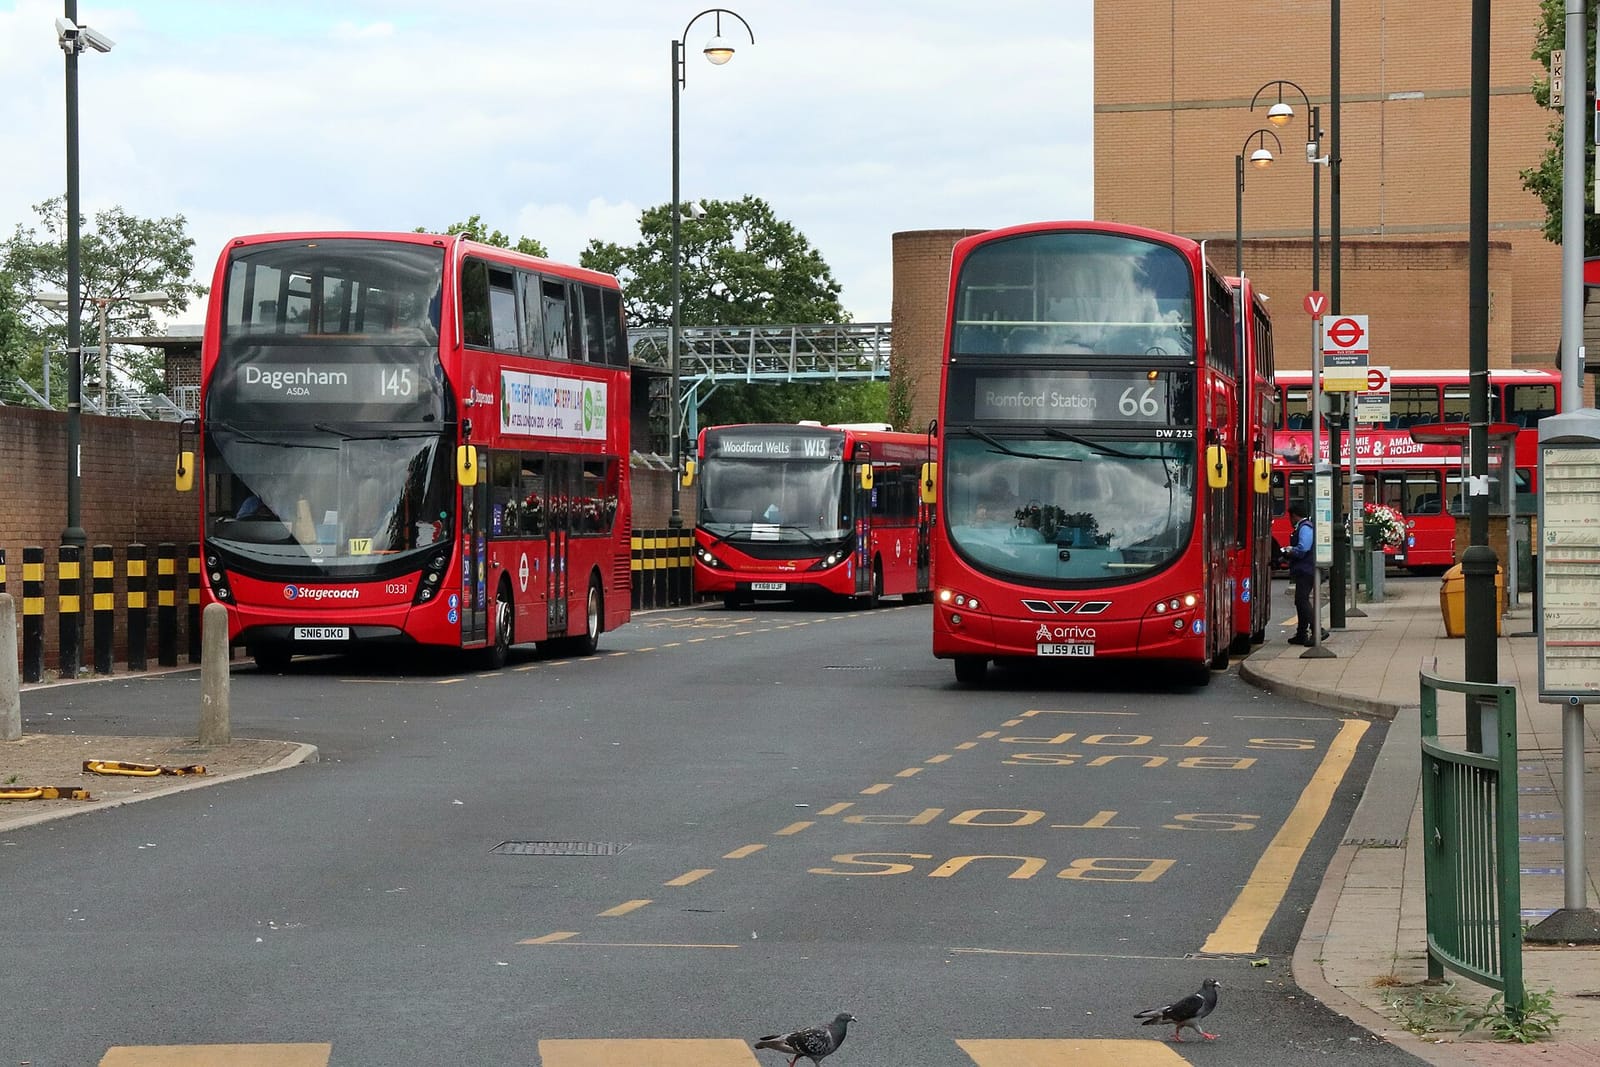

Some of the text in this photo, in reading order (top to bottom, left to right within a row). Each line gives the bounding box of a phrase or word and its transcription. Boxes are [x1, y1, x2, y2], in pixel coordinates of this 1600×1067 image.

[1308, 296, 1324, 313] V
[246, 366, 348, 389] Dagenham
[380, 367, 412, 396] 145
[286, 387, 310, 396] ASDA
[511, 382, 521, 404] THE
[533, 386, 554, 408] HUNGRY
[985, 391, 1097, 409] Romford Station
[1118, 386, 1159, 417] 66
[1155, 430, 1193, 438] DW 225
[1344, 436, 1370, 447] JMIE
[723, 440, 790, 454] Woodford Wells
[803, 439, 826, 457] W13
[1390, 442, 1425, 456] HOLDEN
[353, 539, 369, 552] 117
[298, 587, 360, 601] Stagecoach
[385, 583, 408, 595] 10331
[300, 628, 344, 639] SN16 OKO
[1053, 625, 1097, 638] arriva
[1041, 644, 1091, 655] LJ59 AEU
[998, 732, 1316, 751] STOP
[1001, 752, 1259, 770] BUS
[842, 807, 1262, 832] STOP
[806, 852, 1178, 883] BUS
